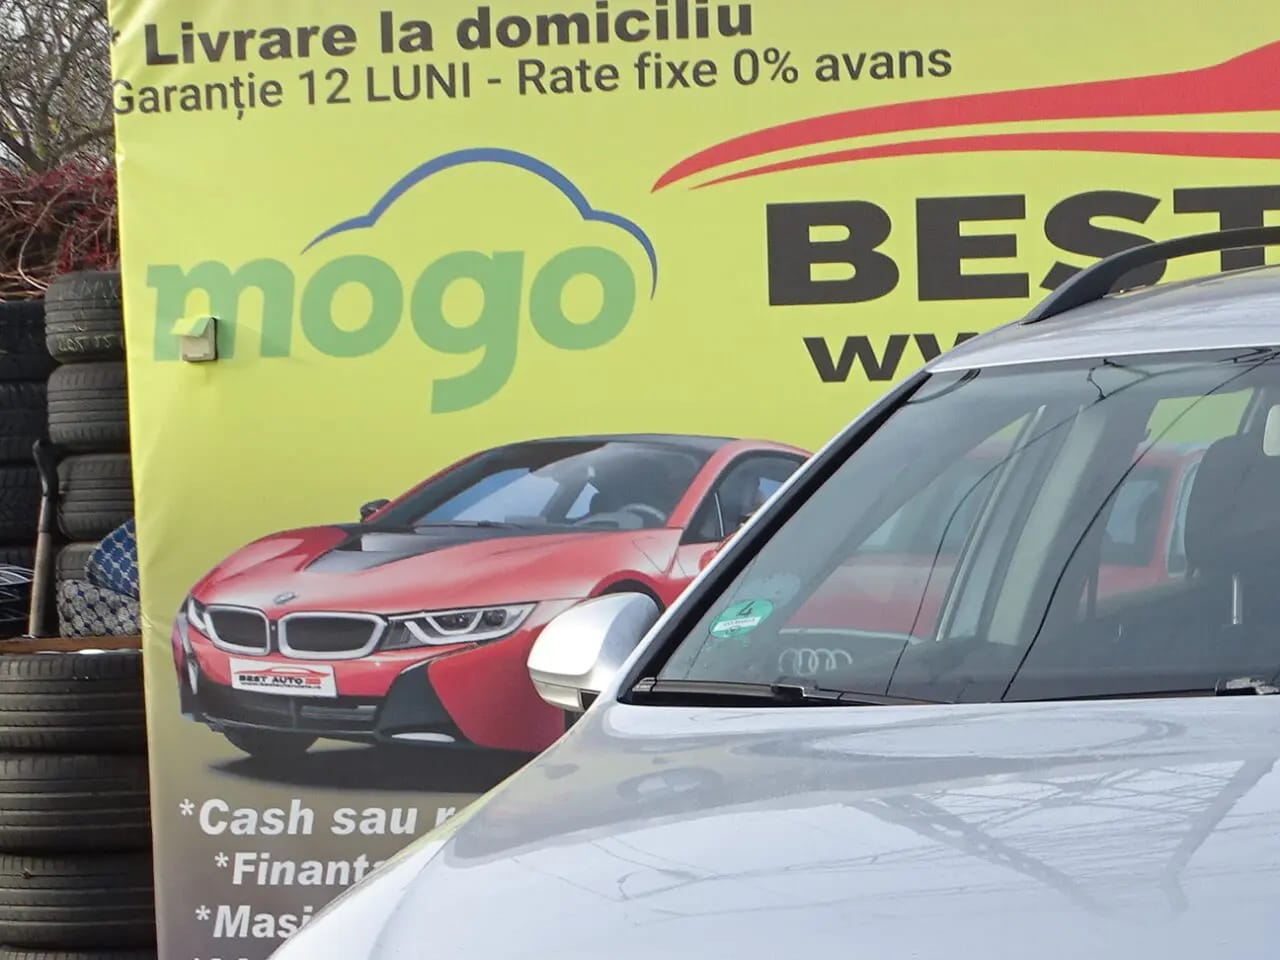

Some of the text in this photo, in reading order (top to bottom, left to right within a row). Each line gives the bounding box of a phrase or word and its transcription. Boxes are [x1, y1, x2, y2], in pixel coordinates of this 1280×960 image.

[144, 0, 753, 65] Livrare la domiciliu
[299, 67, 351, 105] 12
[366, 62, 470, 102] LUNI
[518, 56, 619, 95] Rate
[634, 51, 717, 90] fixe
[733, 47, 799, 85] 0%
[815, 47, 952, 82] avans
[146, 246, 637, 415] mogo
[271, 676, 303, 685] AUTO
[331, 806, 418, 836] sau
